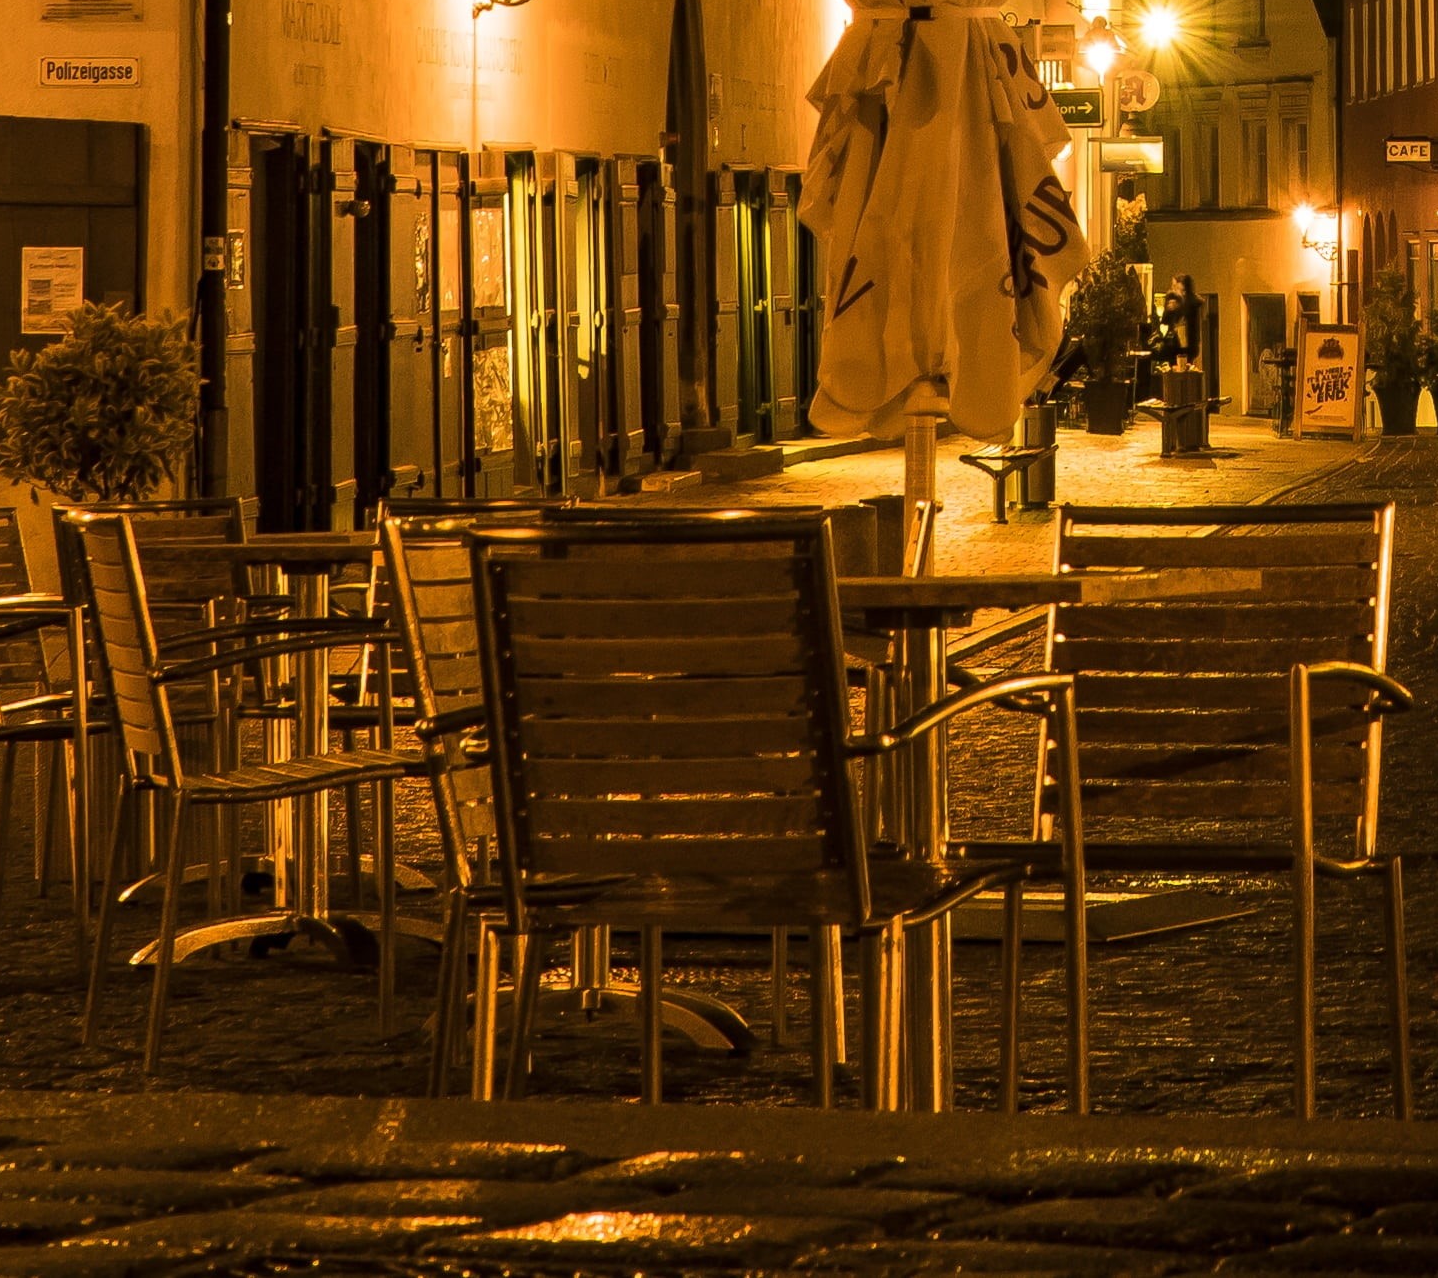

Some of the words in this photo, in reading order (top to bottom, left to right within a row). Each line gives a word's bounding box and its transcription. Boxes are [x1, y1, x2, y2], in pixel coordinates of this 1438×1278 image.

[46, 61, 133, 84] Polizeigasse
[1056, 102, 1076, 114] ion
[1388, 144, 1429, 158] CAFE
[1311, 378, 1350, 394] WEEK
